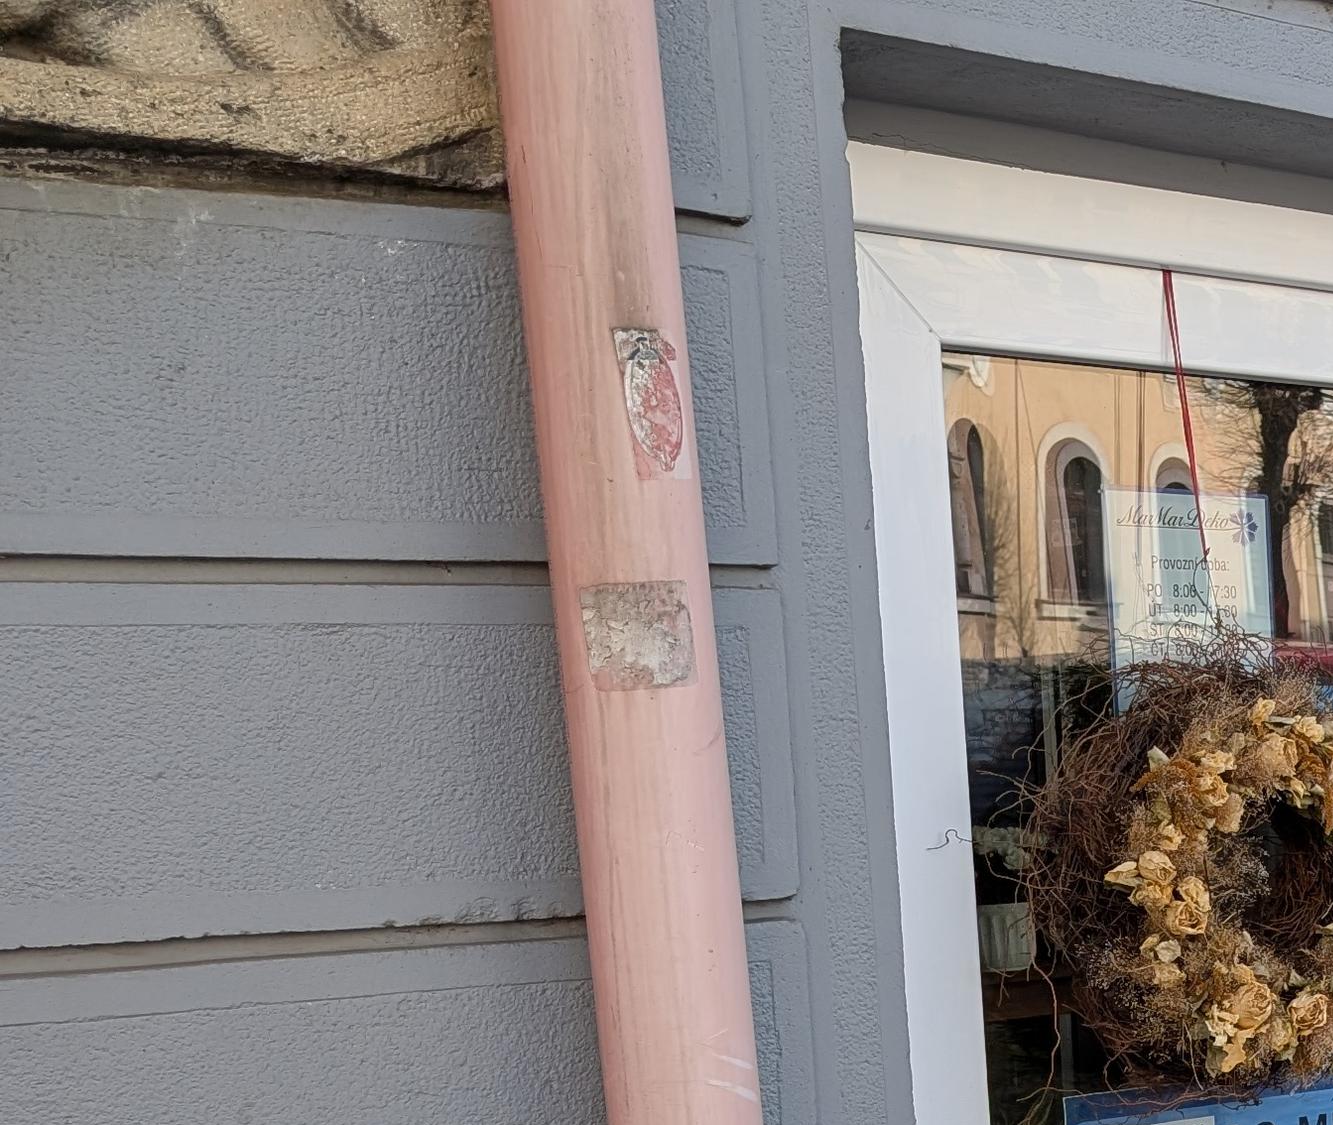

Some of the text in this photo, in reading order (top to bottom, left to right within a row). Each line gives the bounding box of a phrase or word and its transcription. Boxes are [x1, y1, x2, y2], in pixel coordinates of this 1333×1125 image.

[1151, 555, 1198, 571] Provozní
[1147, 583, 1163, 598] PO
[1173, 583, 1197, 598] 8:00
[1148, 598, 1164, 617] ÚT
[1173, 603, 1197, 617] 8:00
[1150, 623, 1164, 637] ST
